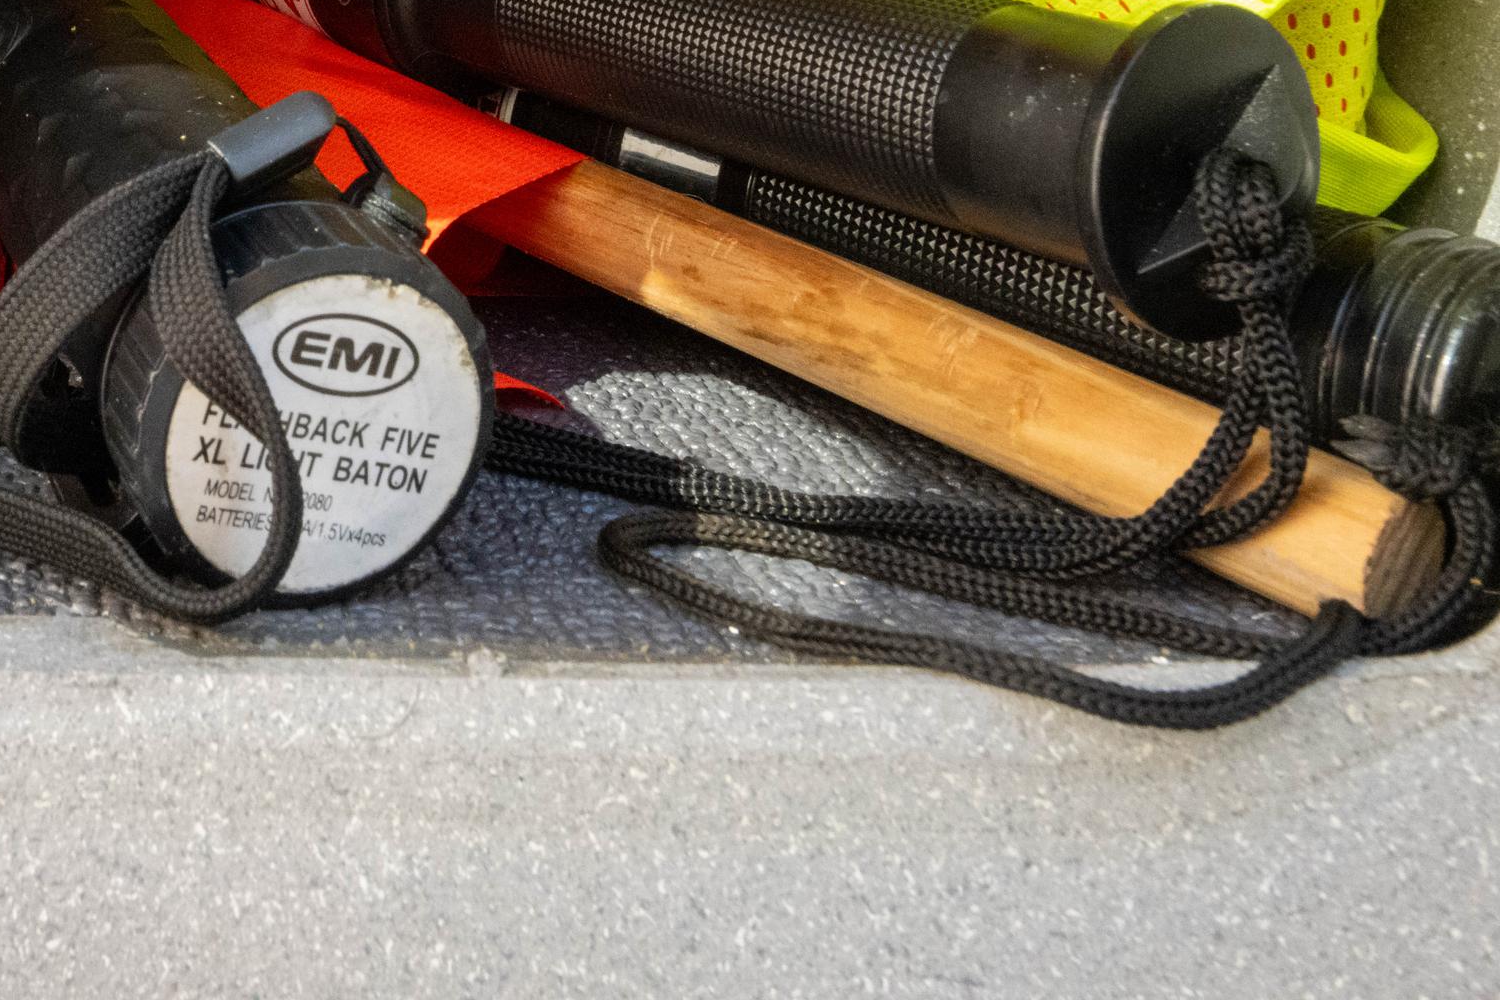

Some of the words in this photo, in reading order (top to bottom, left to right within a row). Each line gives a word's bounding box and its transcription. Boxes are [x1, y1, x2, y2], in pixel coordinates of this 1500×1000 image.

[290, 330, 401, 379] EMI
[203, 401, 370, 448] FLHBACK
[380, 426, 440, 460] FIVE
[192, 435, 226, 465] XL
[333, 456, 428, 494] BATON
[203, 478, 255, 502] MODEL
